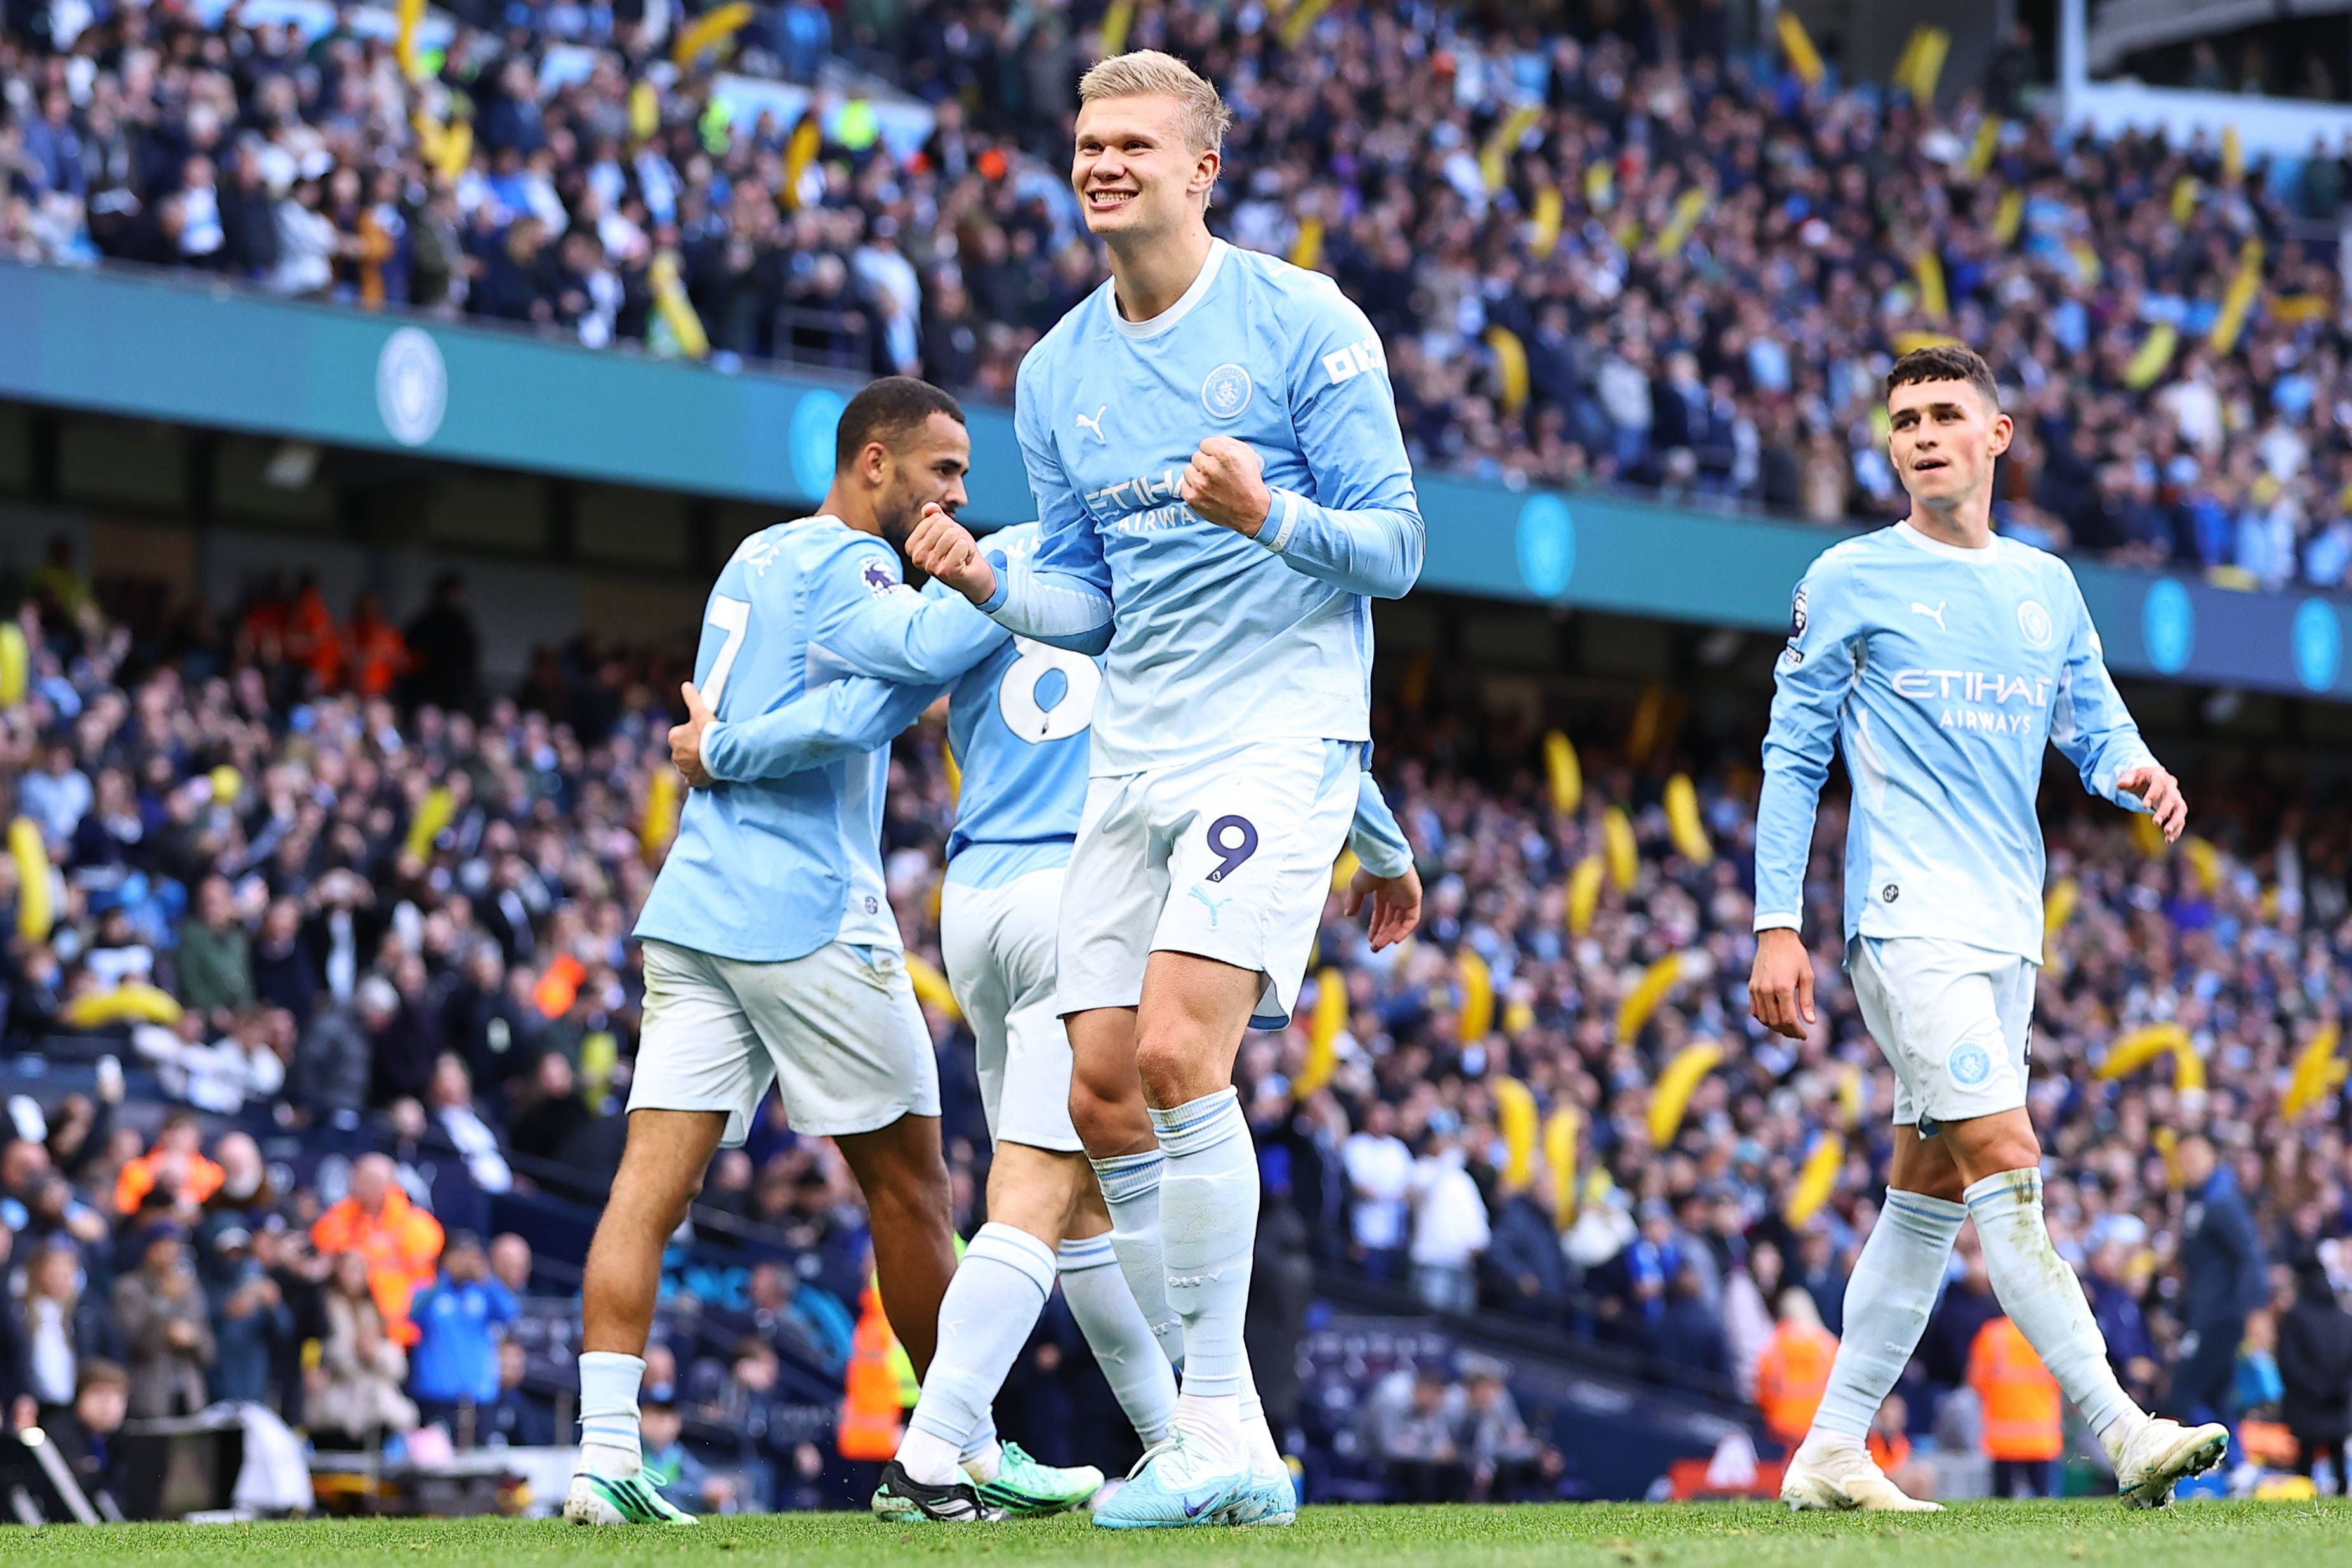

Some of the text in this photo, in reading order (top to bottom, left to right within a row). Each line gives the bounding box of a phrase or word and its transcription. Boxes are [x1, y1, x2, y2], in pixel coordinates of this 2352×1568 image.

[1084, 469, 1186, 520] ETIH
[1118, 505, 1197, 532] AIRWA
[699, 593, 753, 715] 7
[1939, 708, 2032, 735] AIRWAYS
[1205, 814, 1259, 883] 9
